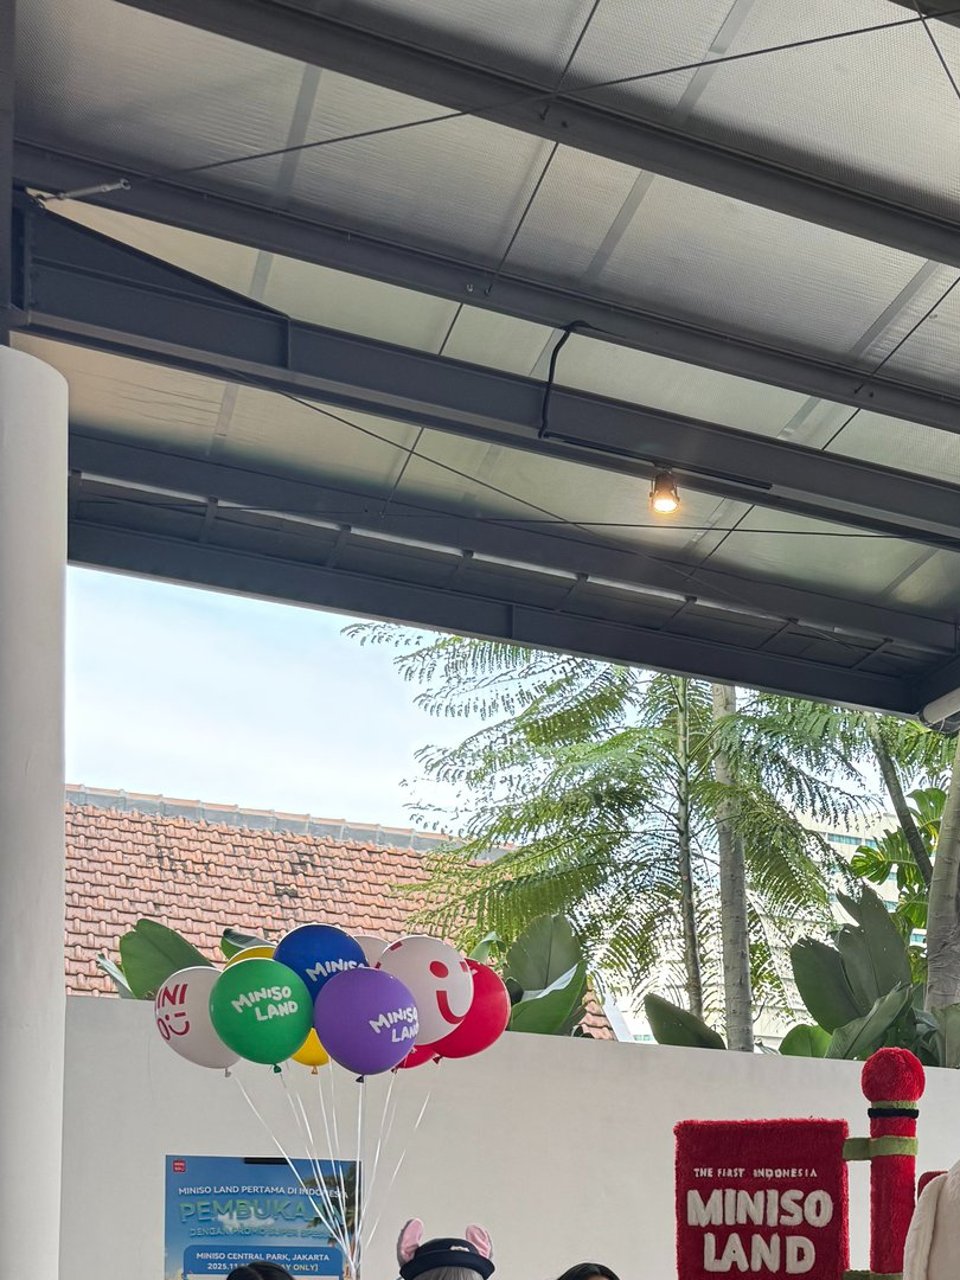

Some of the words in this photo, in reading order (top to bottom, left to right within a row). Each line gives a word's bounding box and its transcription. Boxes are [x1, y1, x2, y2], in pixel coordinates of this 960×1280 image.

[231, 985, 292, 1013] MINISO
[254, 1000, 298, 1021] LAND
[693, 1167, 713, 1178] THE
[717, 1167, 745, 1178] FIRST
[752, 1167, 818, 1179] INDONESIA
[178, 1186, 212, 1195] MINISO
[213, 1185, 239, 1194] LAND
[241, 1185, 285, 1194] PERTAMA
[287, 1187, 297, 1195] DI
[686, 1188, 834, 1228] MINISO
[196, 1252, 226, 1260] MINISO
[703, 1232, 816, 1275] LAND
